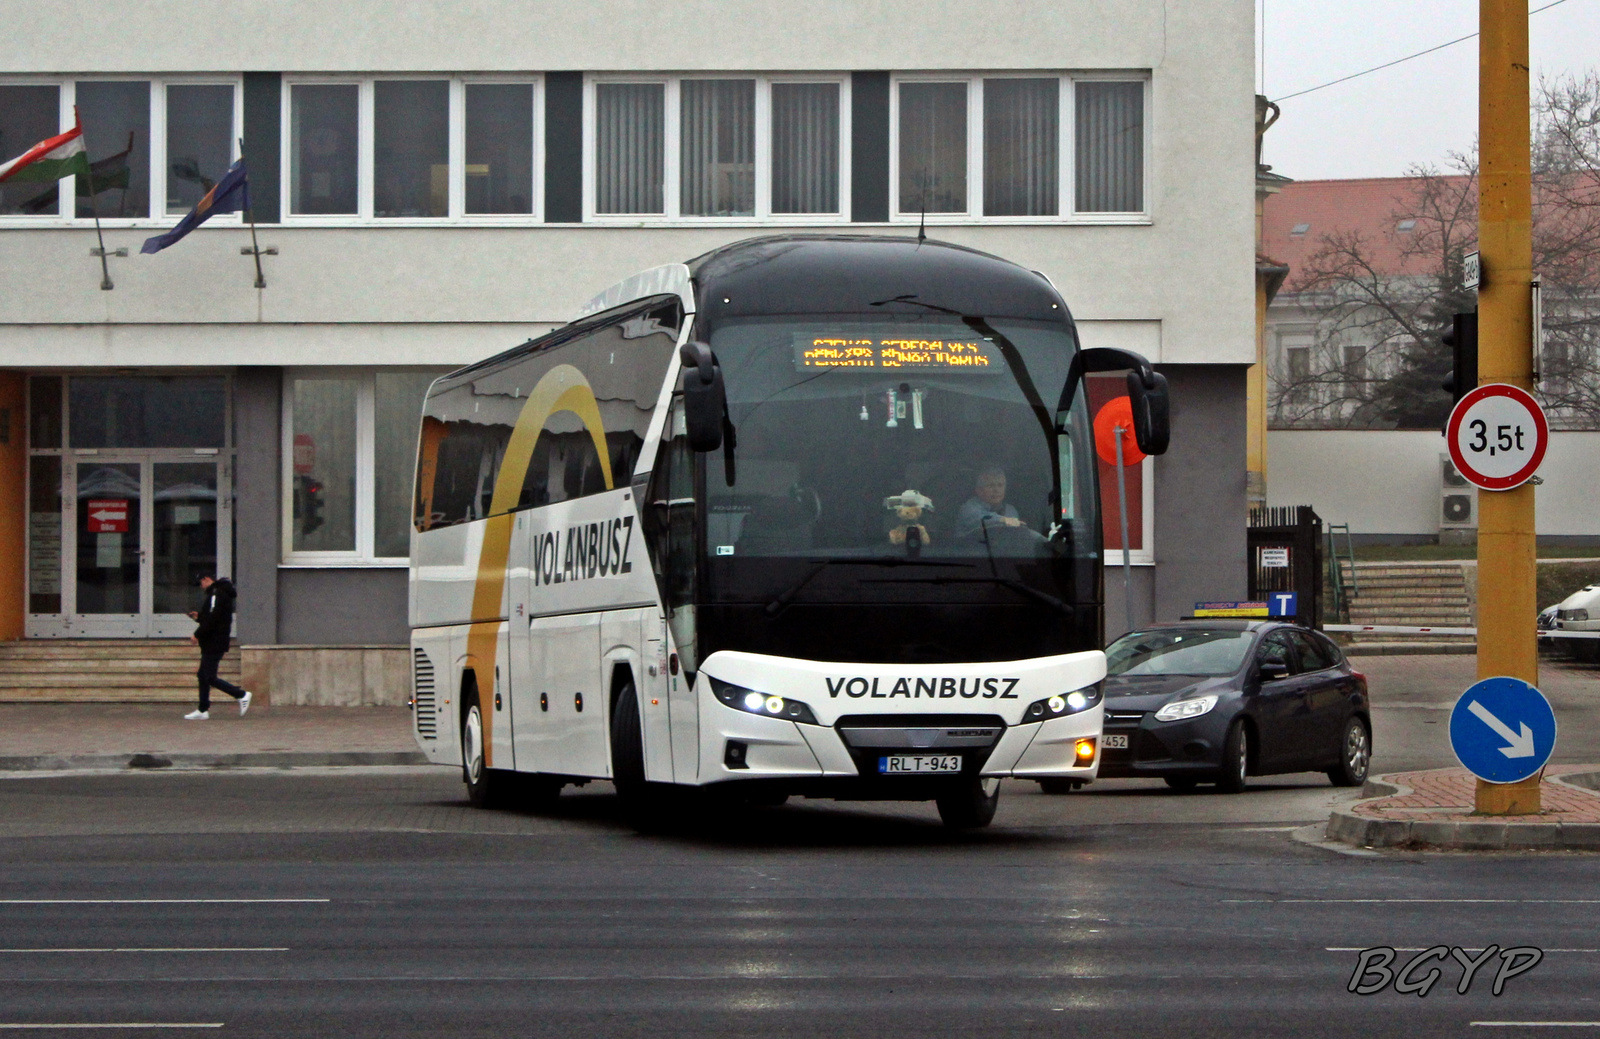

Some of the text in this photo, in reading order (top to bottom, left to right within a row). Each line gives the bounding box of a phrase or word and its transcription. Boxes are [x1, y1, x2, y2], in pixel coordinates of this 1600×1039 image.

[1469, 419, 1524, 456] 3,5t
[534, 515, 634, 587] VOLÁNBUSZ
[1276, 594, 1293, 616] T
[825, 677, 1020, 699] VOLÁNBUSZ
[890, 758, 958, 771] RLT-943
